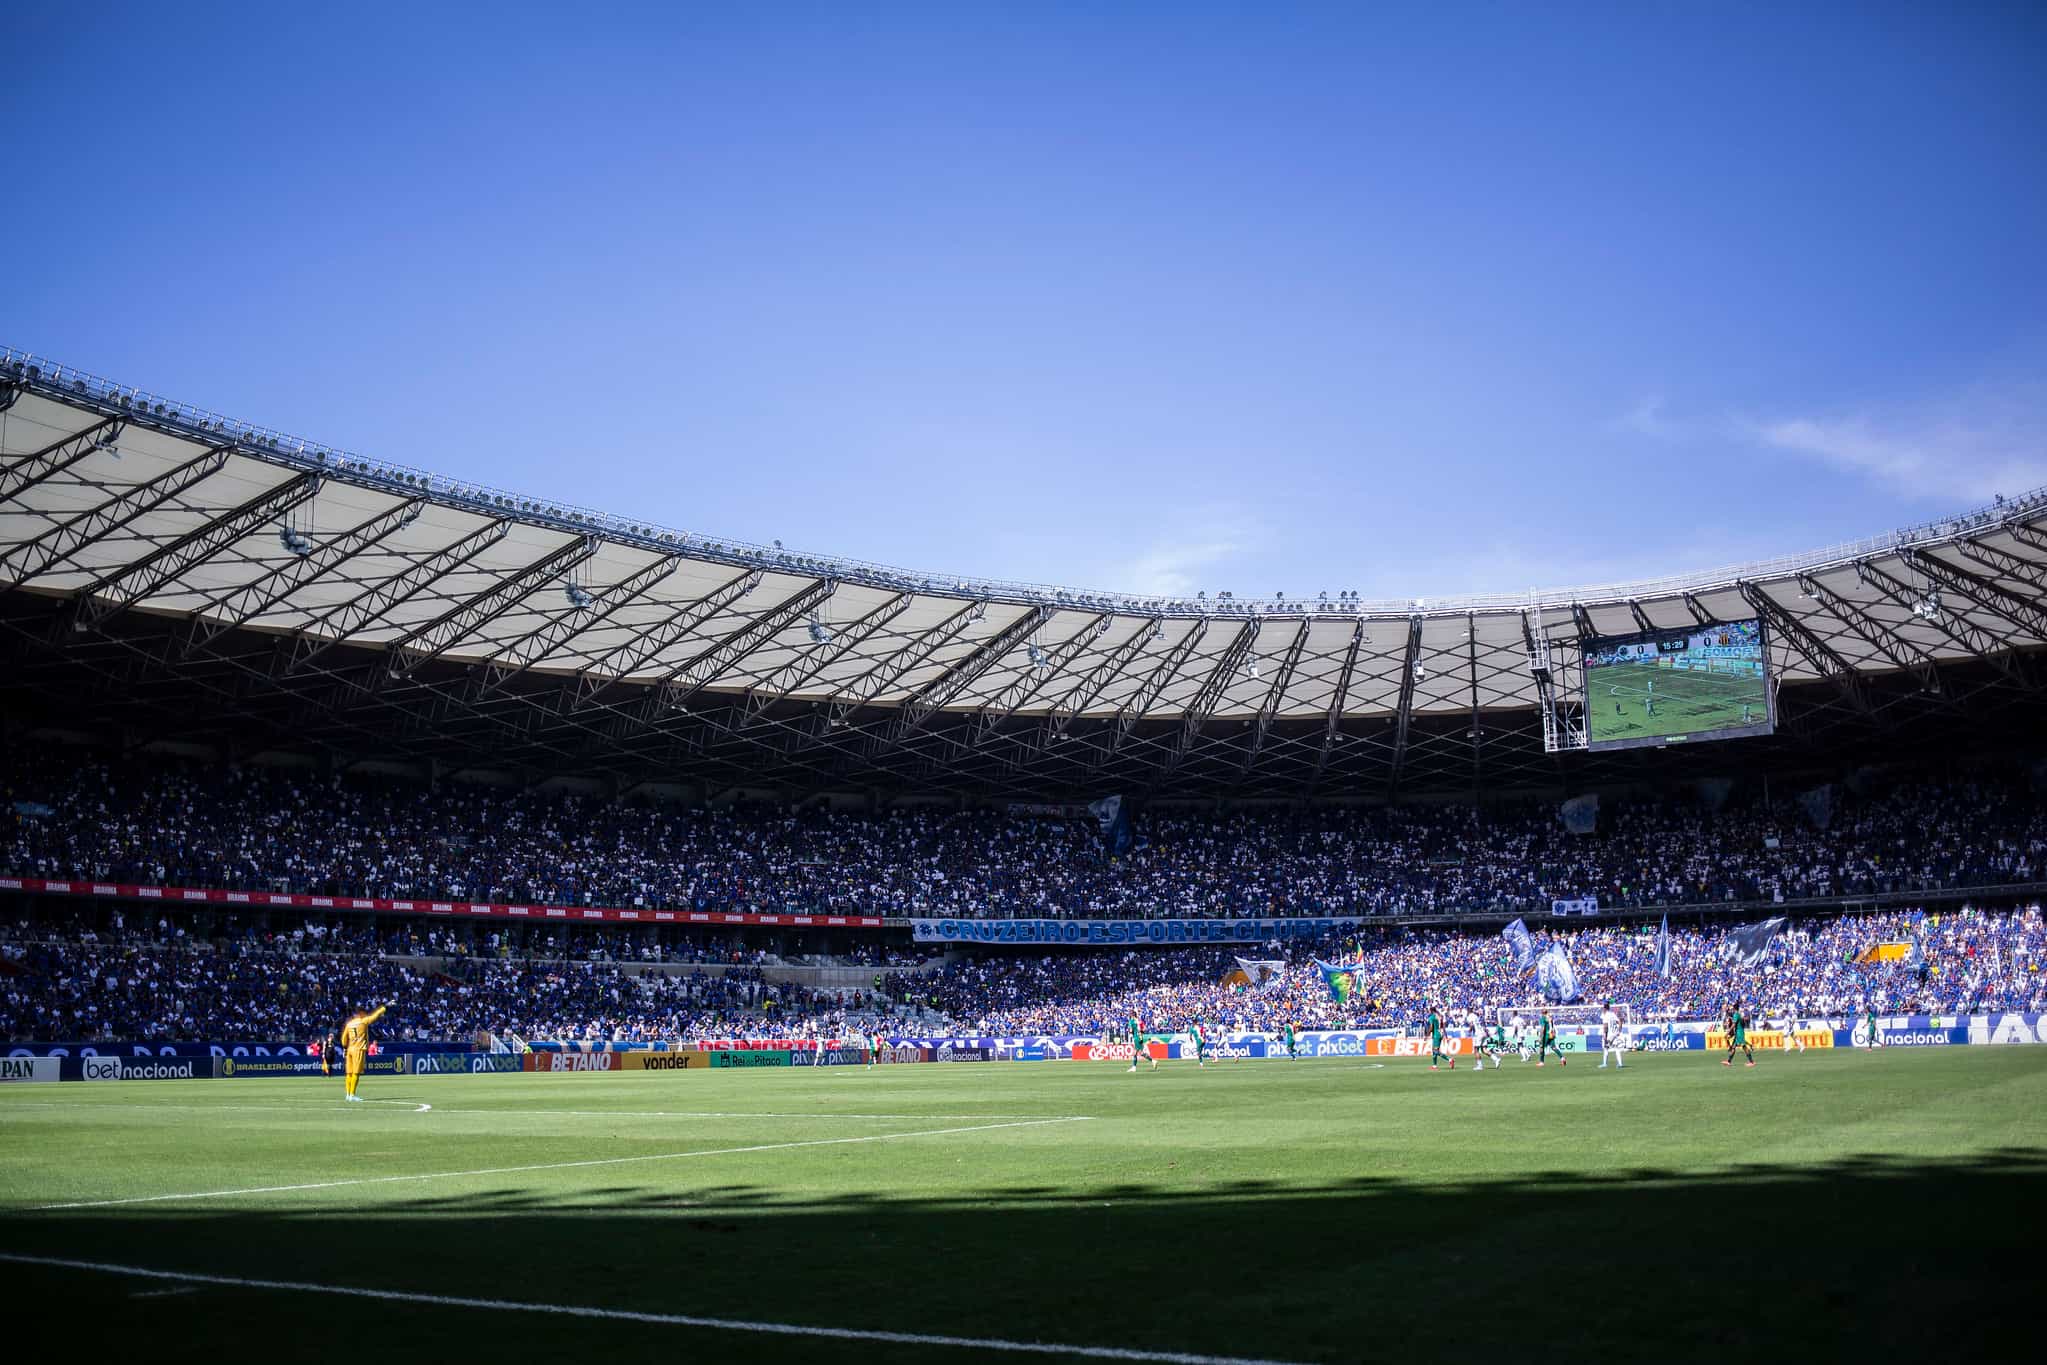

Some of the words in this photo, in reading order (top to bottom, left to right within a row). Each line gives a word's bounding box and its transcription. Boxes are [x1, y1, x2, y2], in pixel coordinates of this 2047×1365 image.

[939, 920, 1081, 942] CRUZEIRO
[1087, 920, 1227, 942] ESPORTE
[881, 1048, 921, 1063] BETANO
[1317, 1038, 1363, 1056] pixbet
[2, 1060, 34, 1078] PAN
[416, 1054, 468, 1075] pixbet
[473, 1054, 521, 1073] pixbet
[551, 1053, 611, 1071] BETANO
[643, 1052, 690, 1070] vonder
